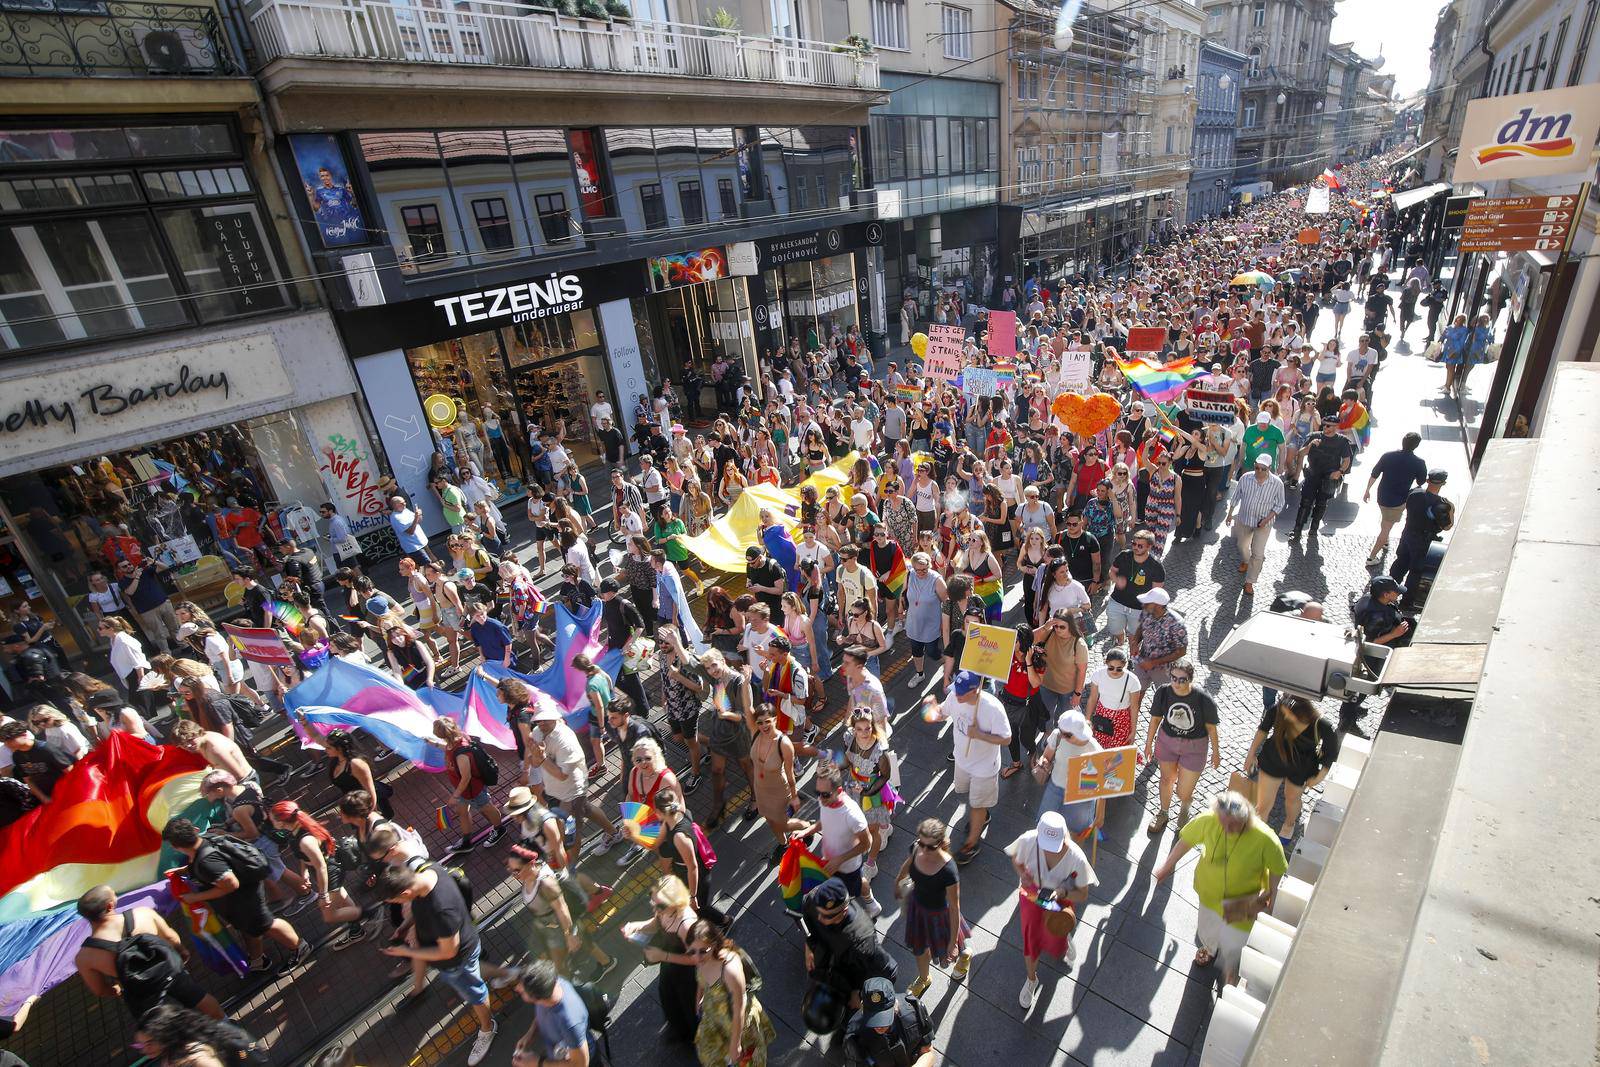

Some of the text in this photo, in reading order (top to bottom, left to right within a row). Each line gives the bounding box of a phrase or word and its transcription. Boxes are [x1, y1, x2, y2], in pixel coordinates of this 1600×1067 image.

[1497, 107, 1572, 145] dm
[1488, 212, 1505, 220] Grad
[233, 218, 263, 282] ULUPUH
[770, 236, 818, 252] BY ALEKSANDRA
[215, 221, 253, 305] GALERIJA
[513, 300, 584, 323] underwear
[613, 346, 636, 358] follow
[928, 359, 959, 377] I'M NOT
[0, 365, 229, 434] etty Barclay
[1192, 400, 1235, 412] SLATKA
